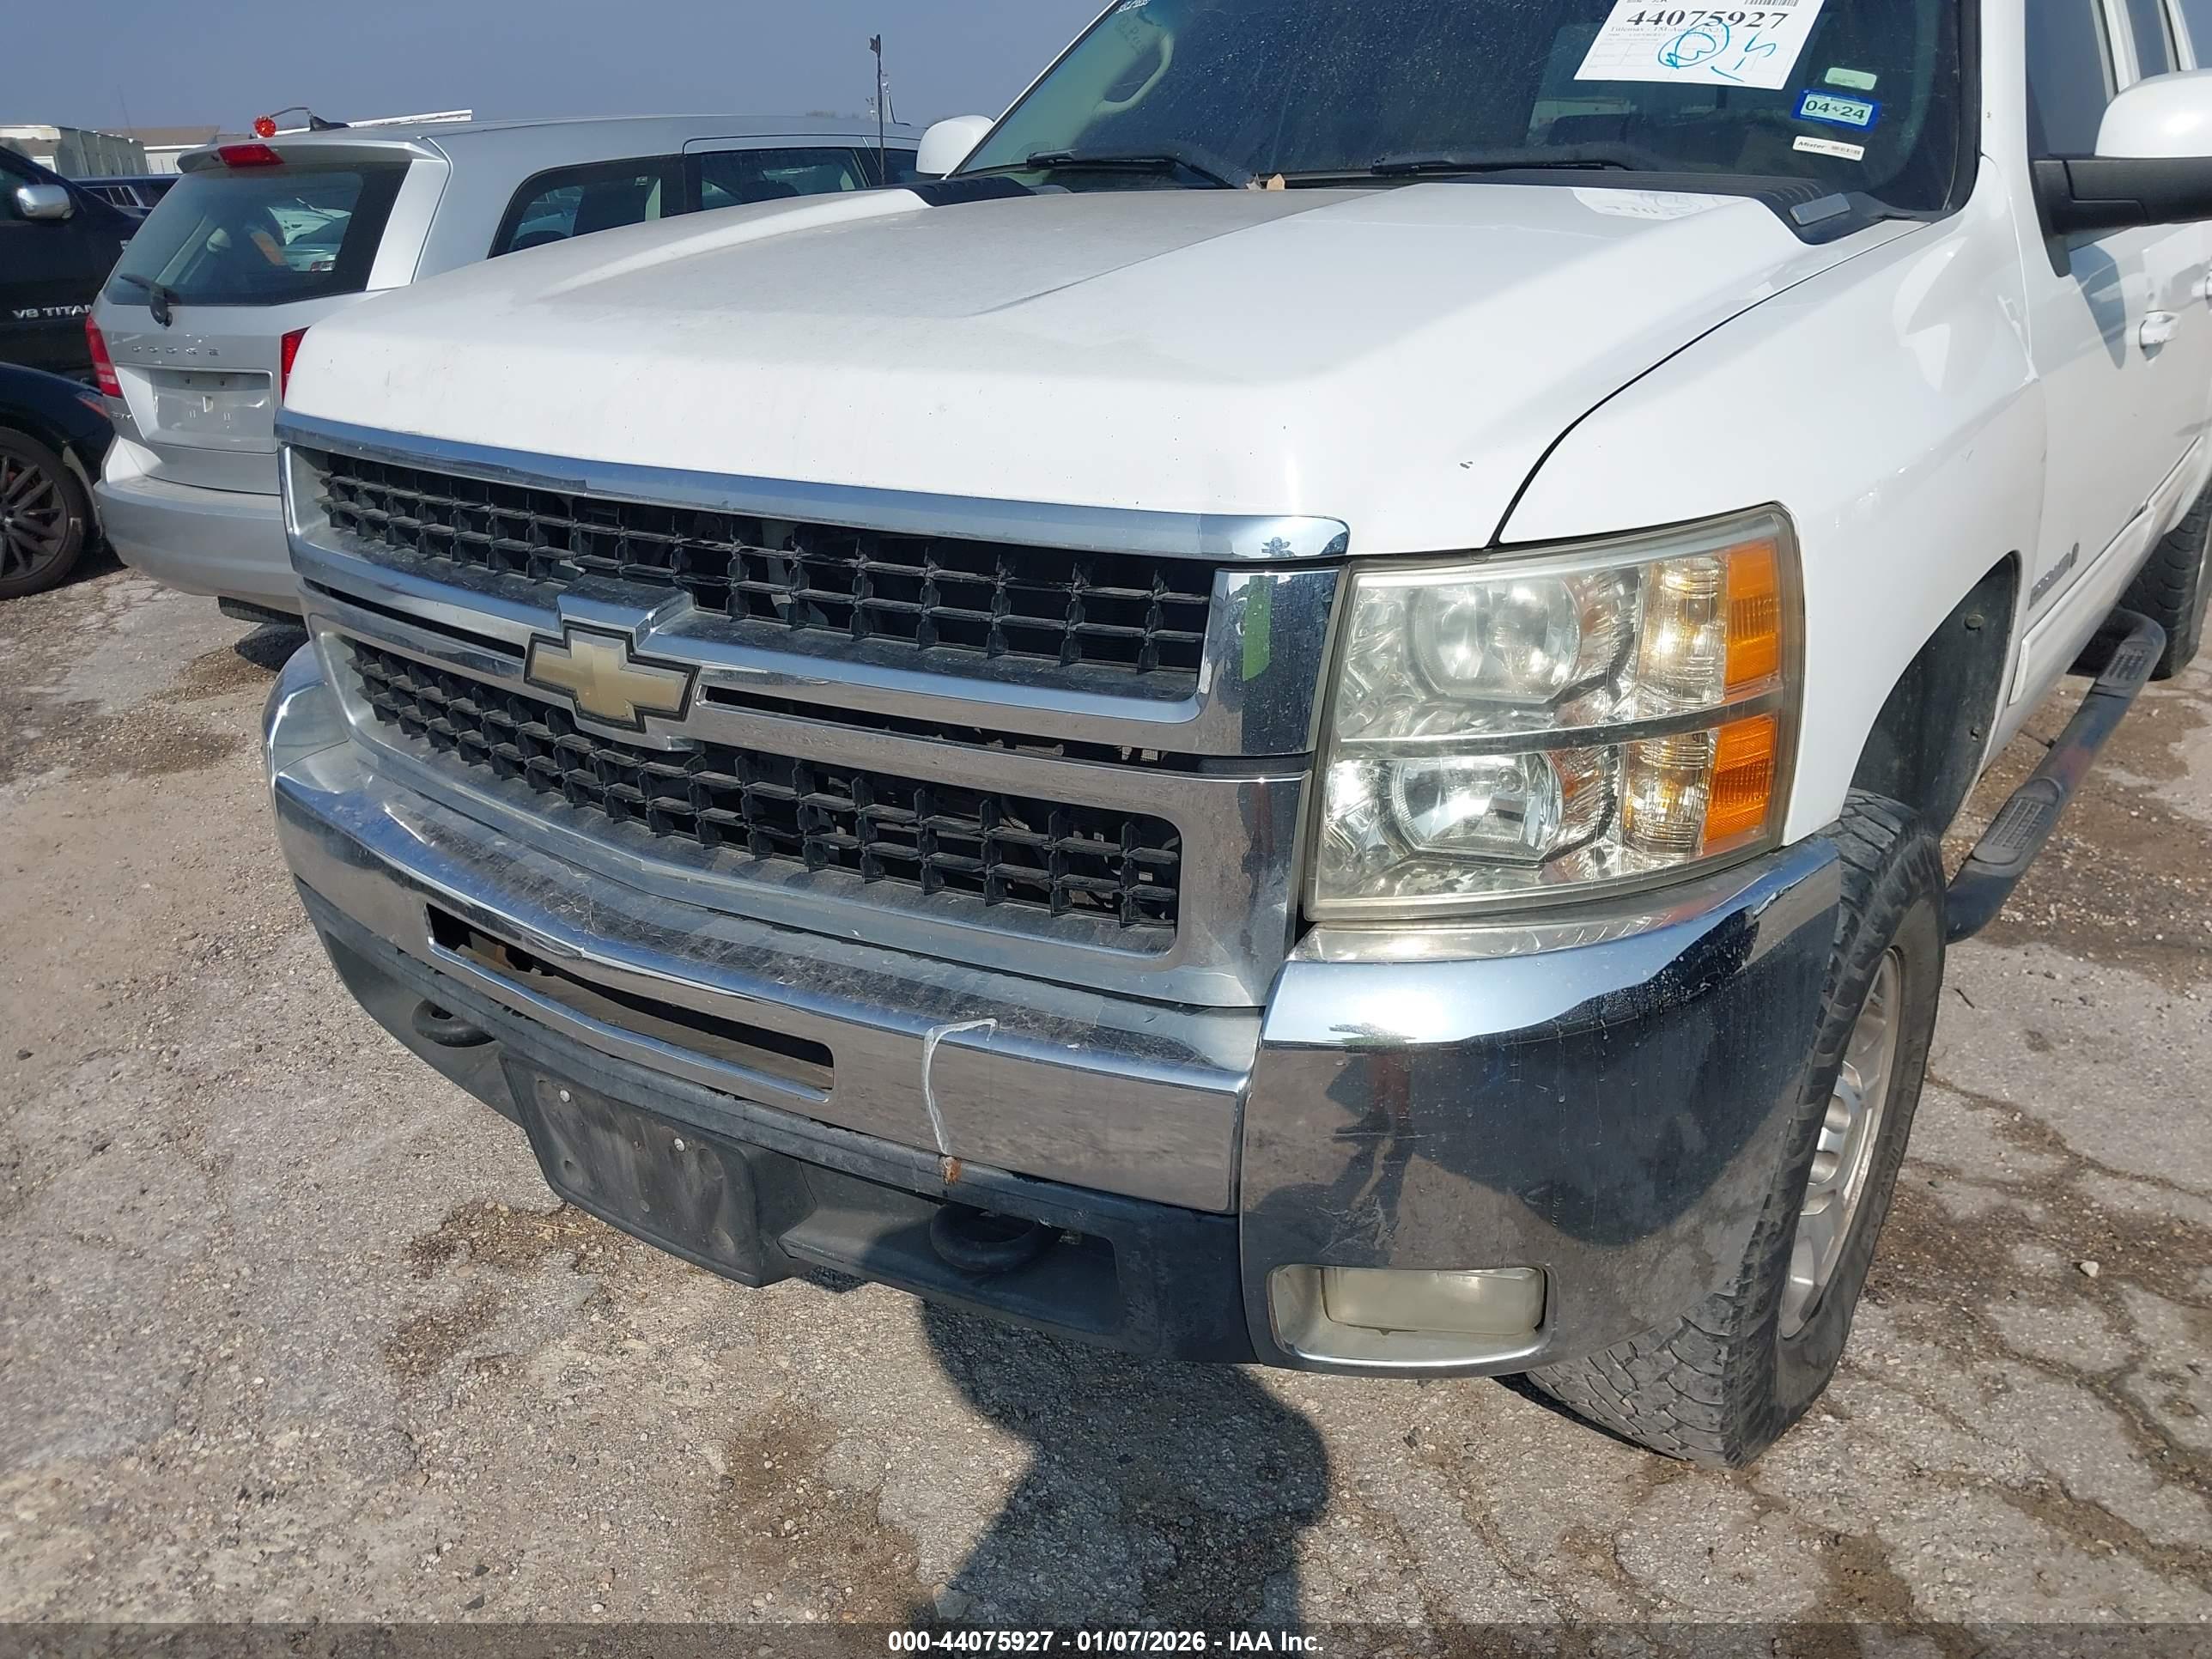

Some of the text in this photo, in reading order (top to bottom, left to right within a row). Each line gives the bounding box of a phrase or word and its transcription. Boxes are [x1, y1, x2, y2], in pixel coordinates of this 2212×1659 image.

[1627, 10, 1789, 29] 44075927
[1805, 100, 1866, 120] 04 24
[12, 308, 39, 319] V8
